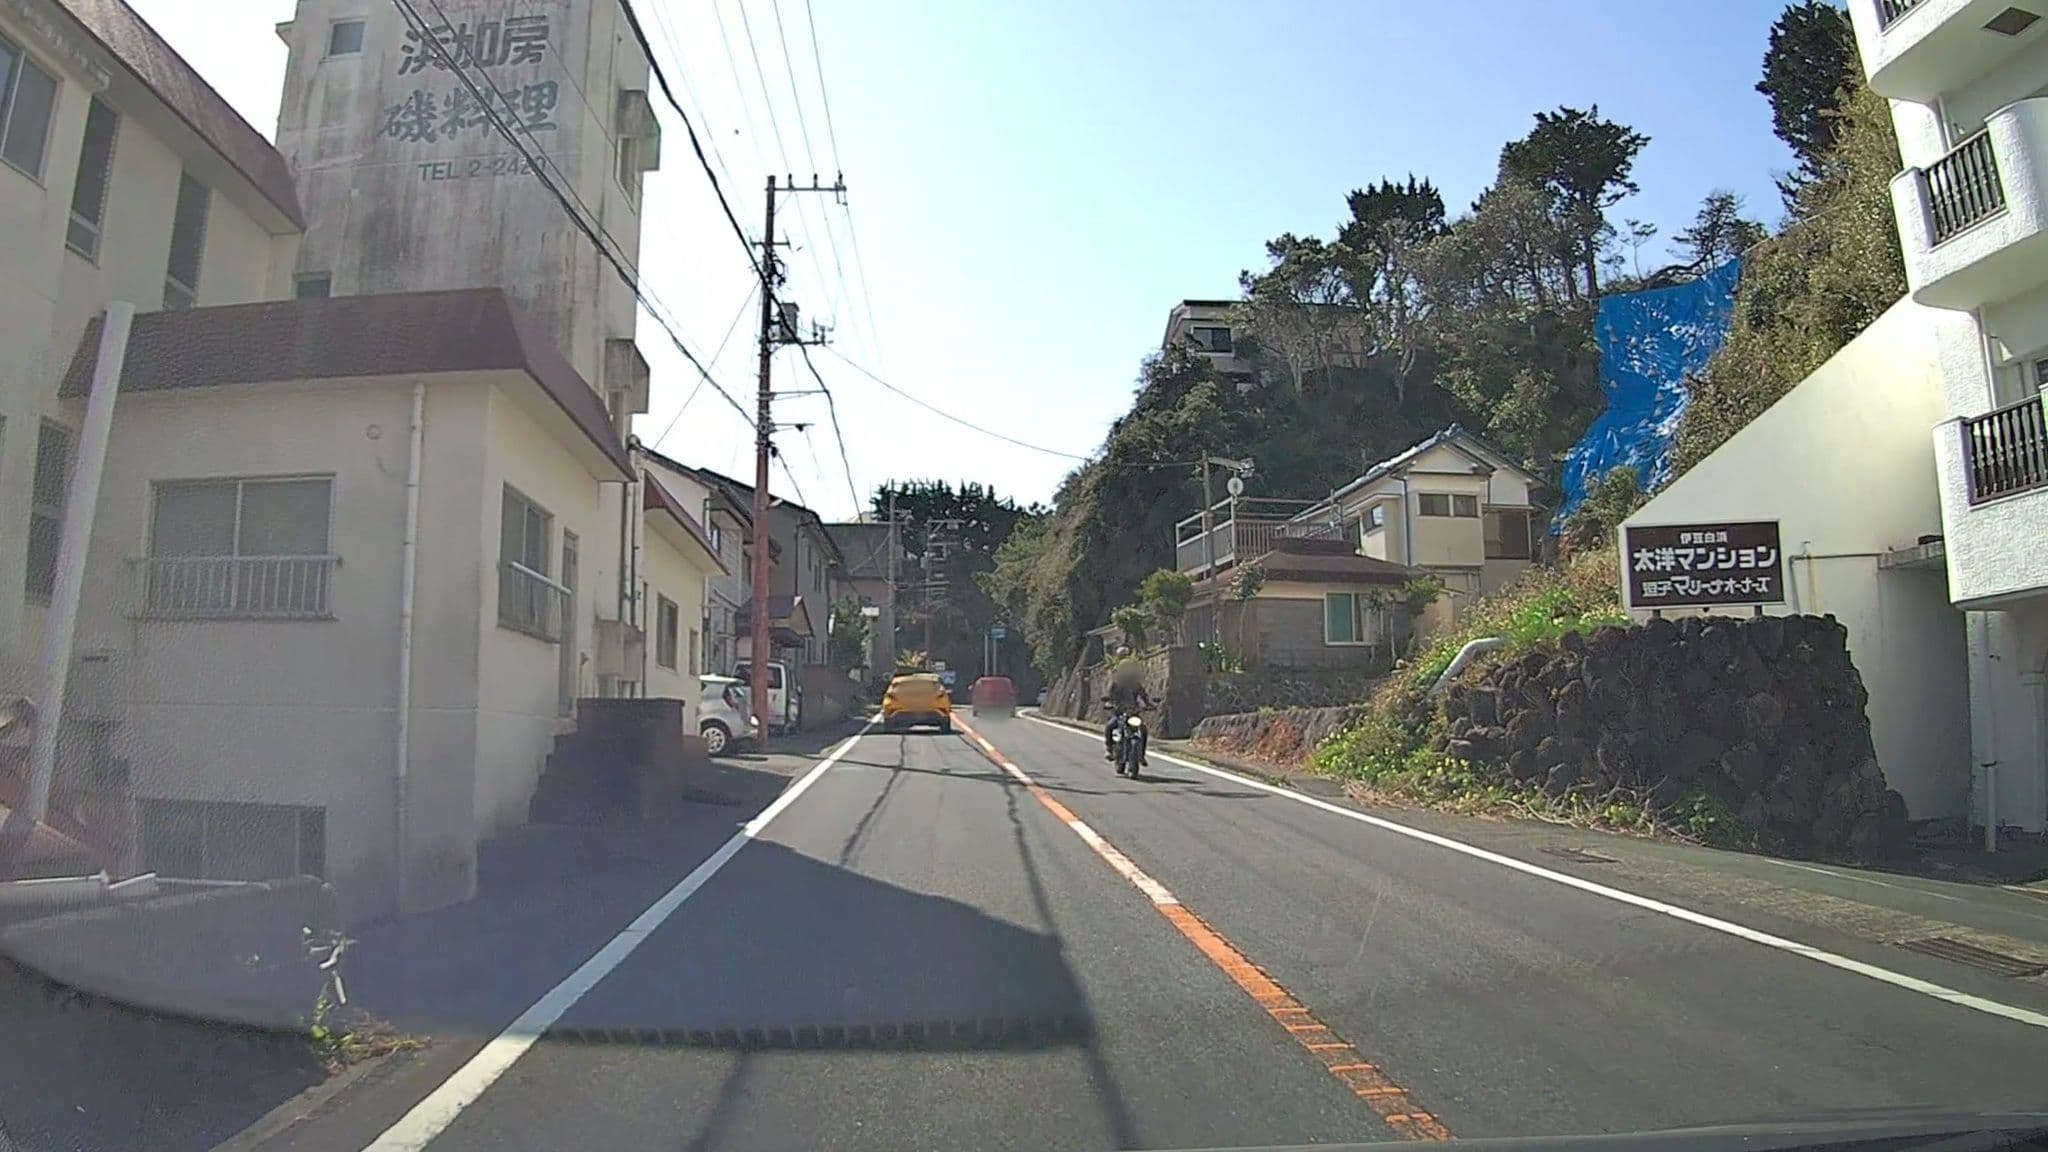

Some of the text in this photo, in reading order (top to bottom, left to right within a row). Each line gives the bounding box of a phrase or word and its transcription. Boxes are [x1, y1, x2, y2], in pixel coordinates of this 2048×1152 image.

[377, 80, 559, 143] 磯料理
[418, 161, 459, 181] TEL
[1633, 546, 1776, 572] 太洋マンション
